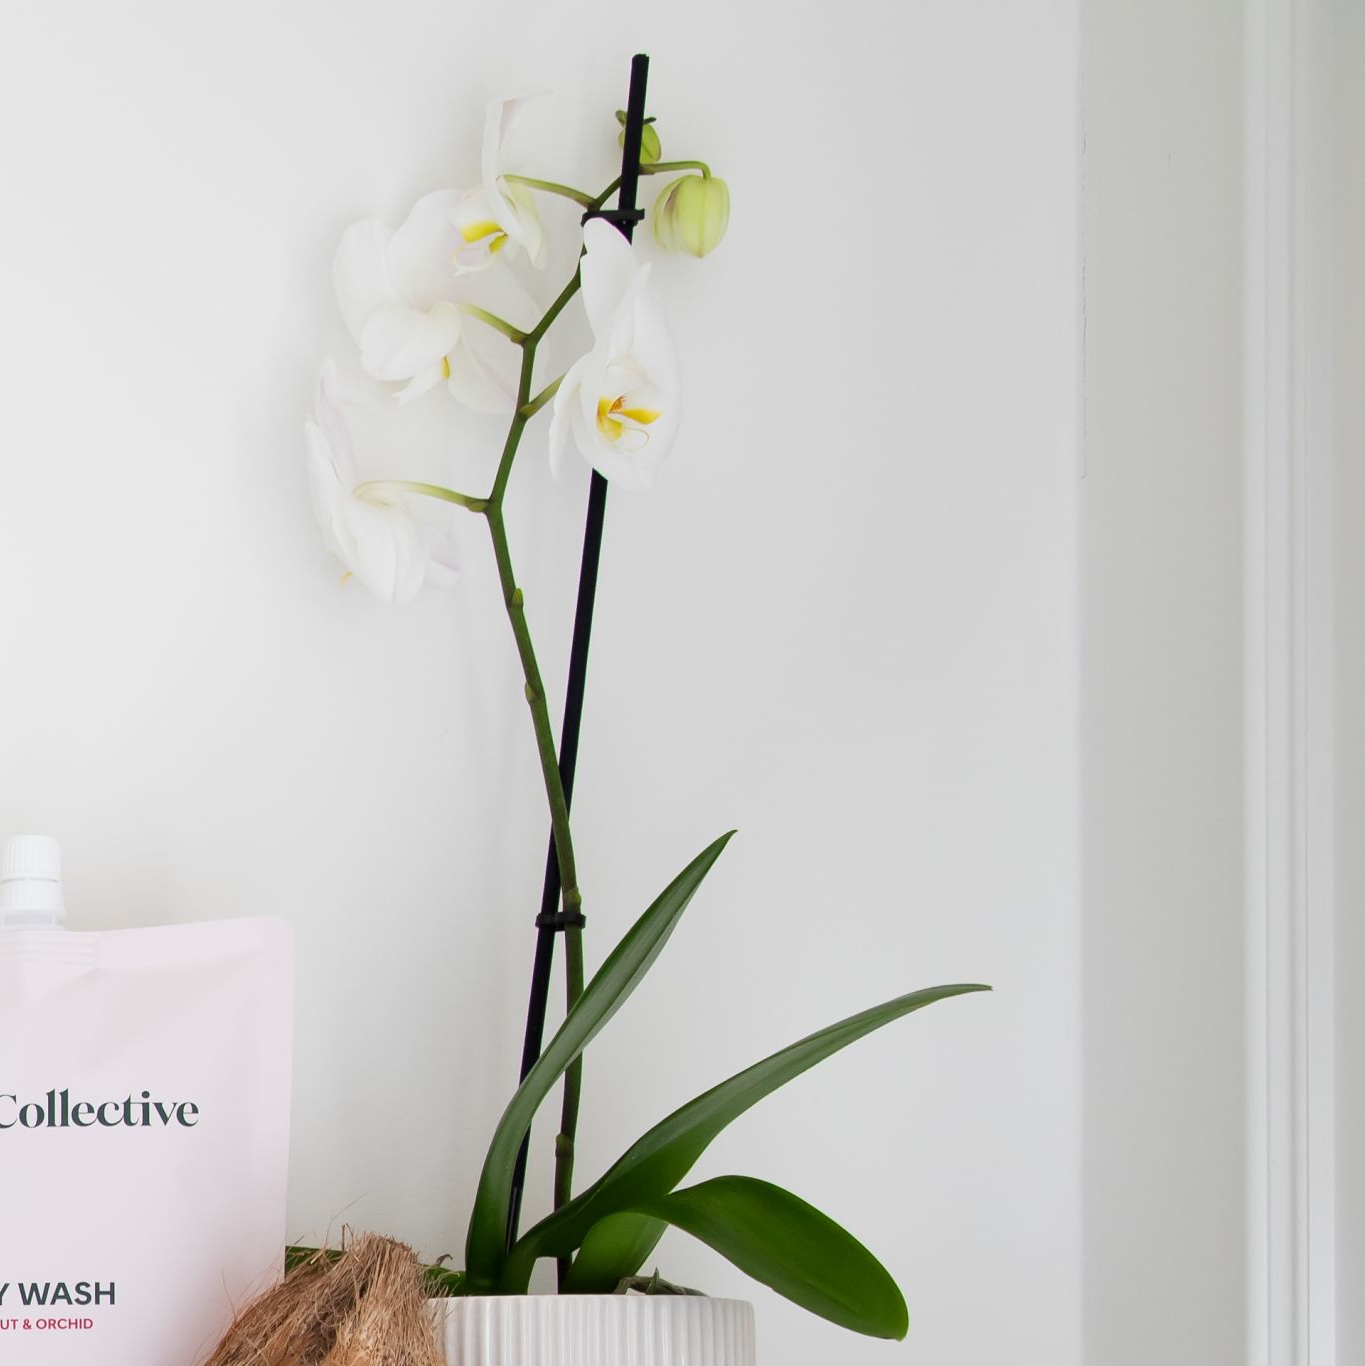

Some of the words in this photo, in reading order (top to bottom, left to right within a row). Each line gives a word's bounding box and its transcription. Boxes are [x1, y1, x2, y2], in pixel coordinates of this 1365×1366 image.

[18, 1282, 115, 1305] WASH
[23, 1319, 32, 1330] &
[36, 1318, 93, 1330] ORCHID
